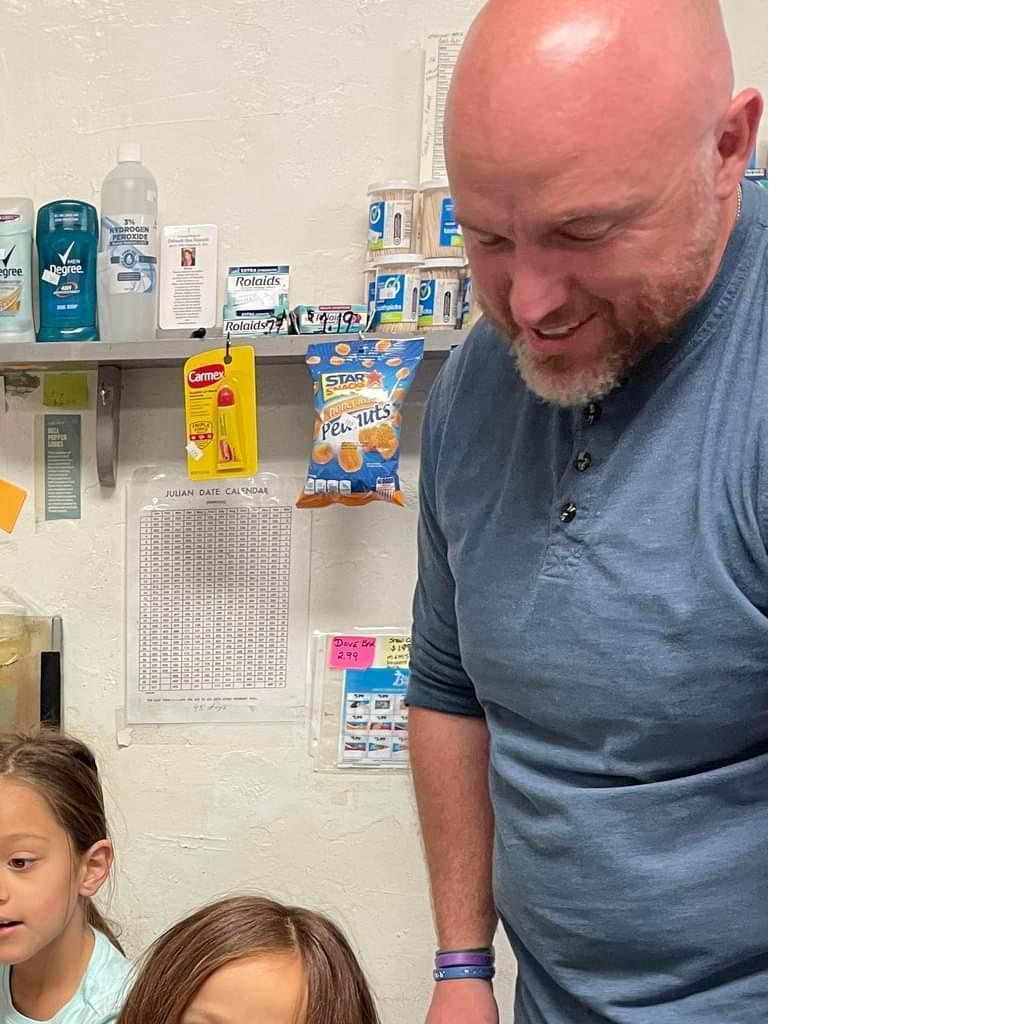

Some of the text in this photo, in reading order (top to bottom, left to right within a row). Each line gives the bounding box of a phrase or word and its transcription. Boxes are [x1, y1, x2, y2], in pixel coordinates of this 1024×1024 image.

[49, 264, 84, 277] Degree
[235, 275, 281, 288] Rolaids
[225, 320, 267, 331] Rolaids
[189, 370, 225, 383] Carmex
[325, 373, 366, 387] STAR
[164, 486, 269, 498] JULIAN DATE CALENDAR
